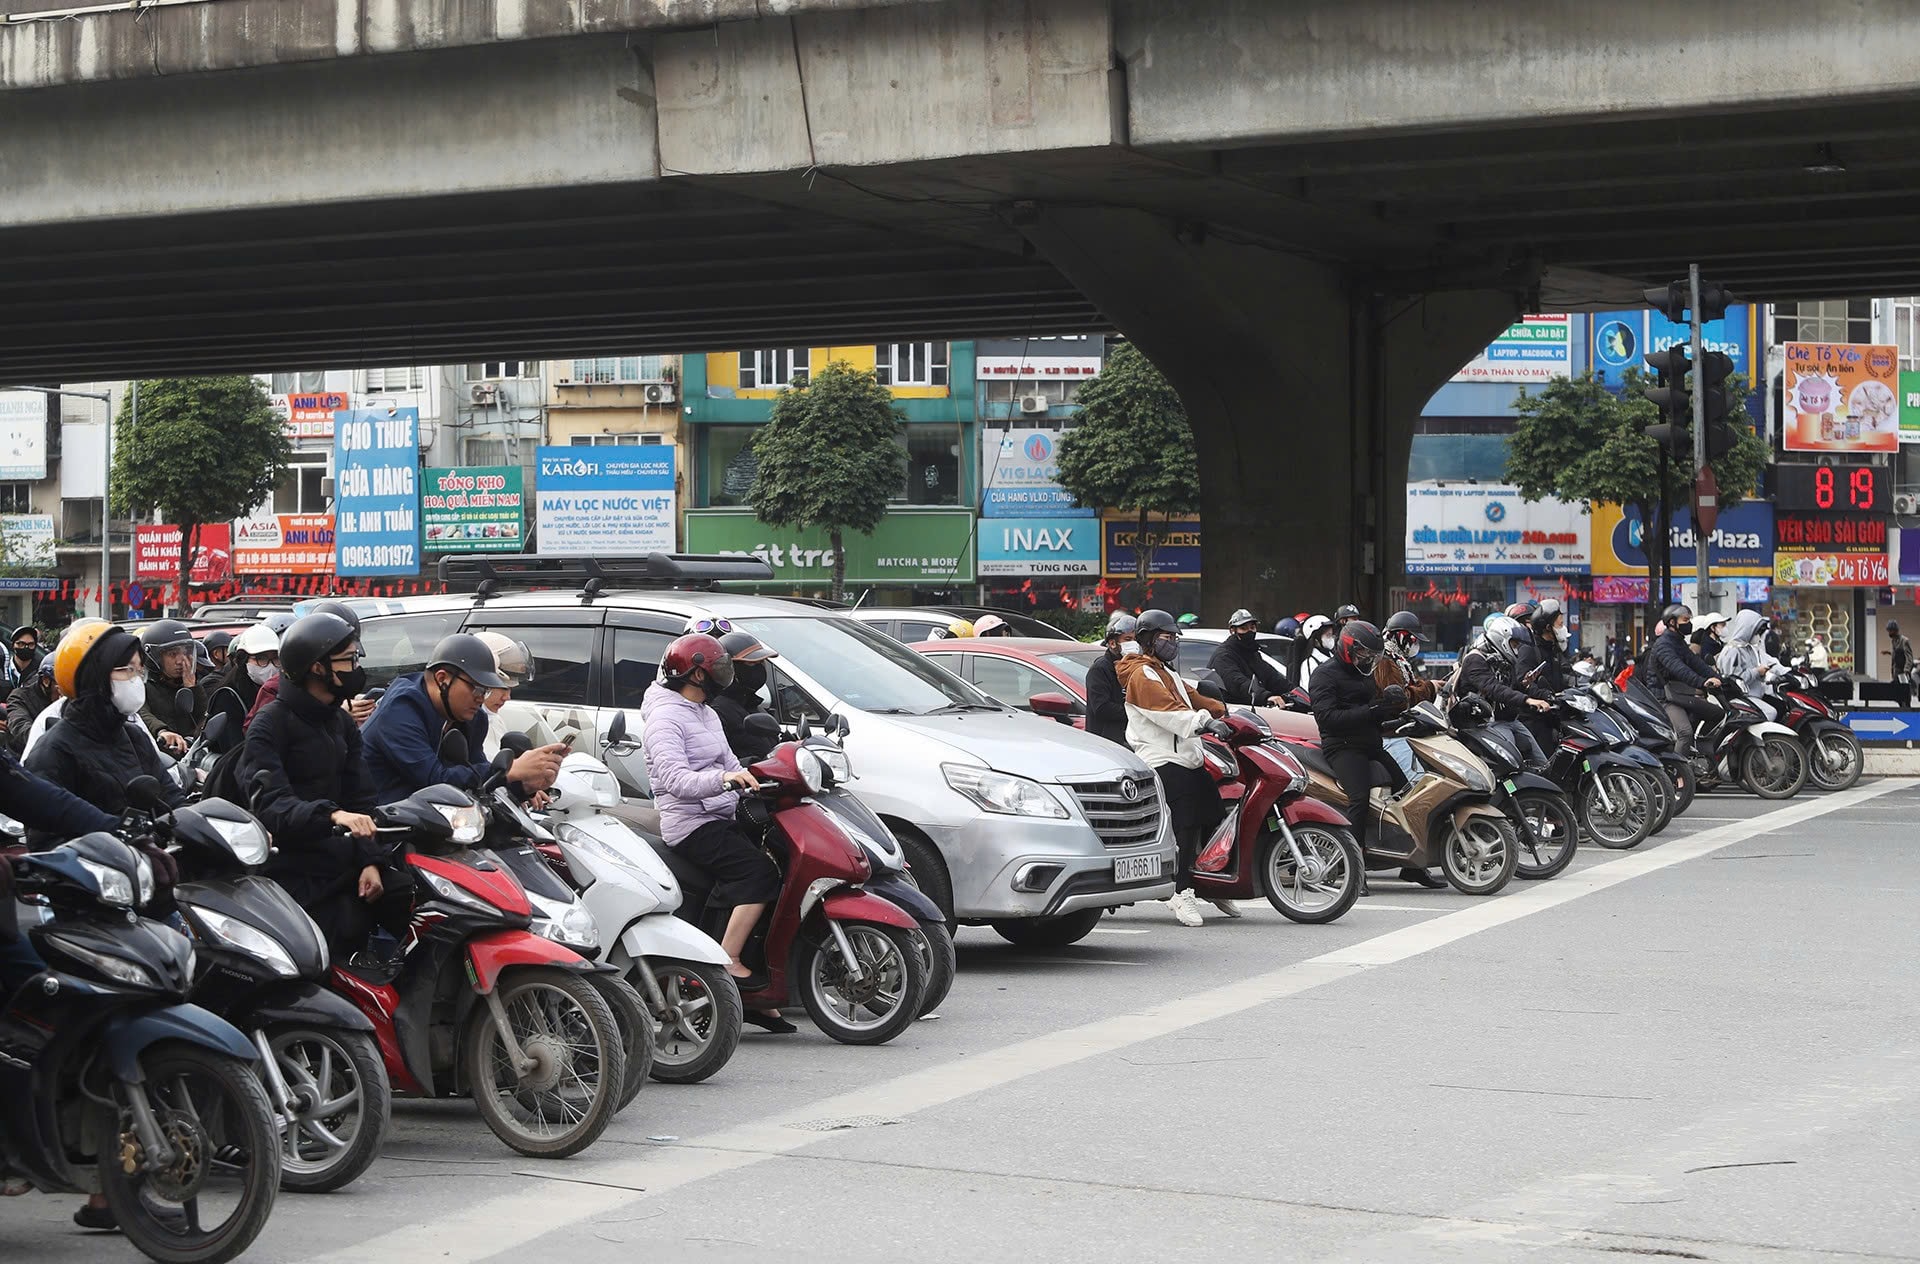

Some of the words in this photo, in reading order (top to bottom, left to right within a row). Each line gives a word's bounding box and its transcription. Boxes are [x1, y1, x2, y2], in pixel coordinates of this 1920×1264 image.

[1787, 345, 1810, 361] Chè
[1816, 344, 1832, 361] Tổ
[1836, 344, 1862, 362] Yến
[294, 397, 316, 408] ANH
[341, 422, 372, 451] CHO
[375, 415, 412, 449] THUÊ
[542, 459, 598, 476] KAROFI
[340, 462, 370, 498] CỬA
[373, 464, 414, 496] HÀNG
[439, 470, 475, 490] TỔNG
[476, 476, 505, 490] KHO
[424, 495, 446, 508] HOA
[447, 490, 468, 510] QUẢ
[470, 489, 494, 507] MIỀN
[496, 493, 520, 506] NAM
[542, 496, 571, 510] MÁY
[575, 499, 599, 513] LỌC
[602, 497, 638, 510] NƯỚC
[642, 497, 670, 512] VIỆT
[34, 520, 52, 530] NGA
[341, 512, 357, 533] LH:
[360, 511, 382, 532] ANH
[384, 504, 414, 532] TUẤN
[138, 531, 161, 544] QUÁN
[286, 530, 308, 545] ANH
[312, 527, 334, 546] LỘC
[1778, 514, 1804, 544] YẾN
[1806, 516, 1832, 544] SÀO
[1834, 516, 1856, 544] SÀI
[1858, 517, 1884, 544] GÒN
[1004, 528, 1074, 551] INAX
[142, 544, 159, 558] GIẢI
[160, 544, 182, 558] KHÁT
[342, 544, 414, 568] 0903.801972
[138, 560, 158, 571] BÁNH
[878, 558, 918, 566] MATCHA
[922, 558, 928, 566] &
[931, 558, 958, 566] MORE
[1030, 562, 1060, 572] TÙNG
[1063, 564, 1088, 572] NGA
[1840, 558, 1854, 580] Chè
[1857, 556, 1869, 580] Tổ
[1871, 556, 1888, 580] Yến
[842, 592, 854, 600] 32
[1116, 856, 1160, 880] 30A-666.11
[221, 967, 254, 982] HONDA
